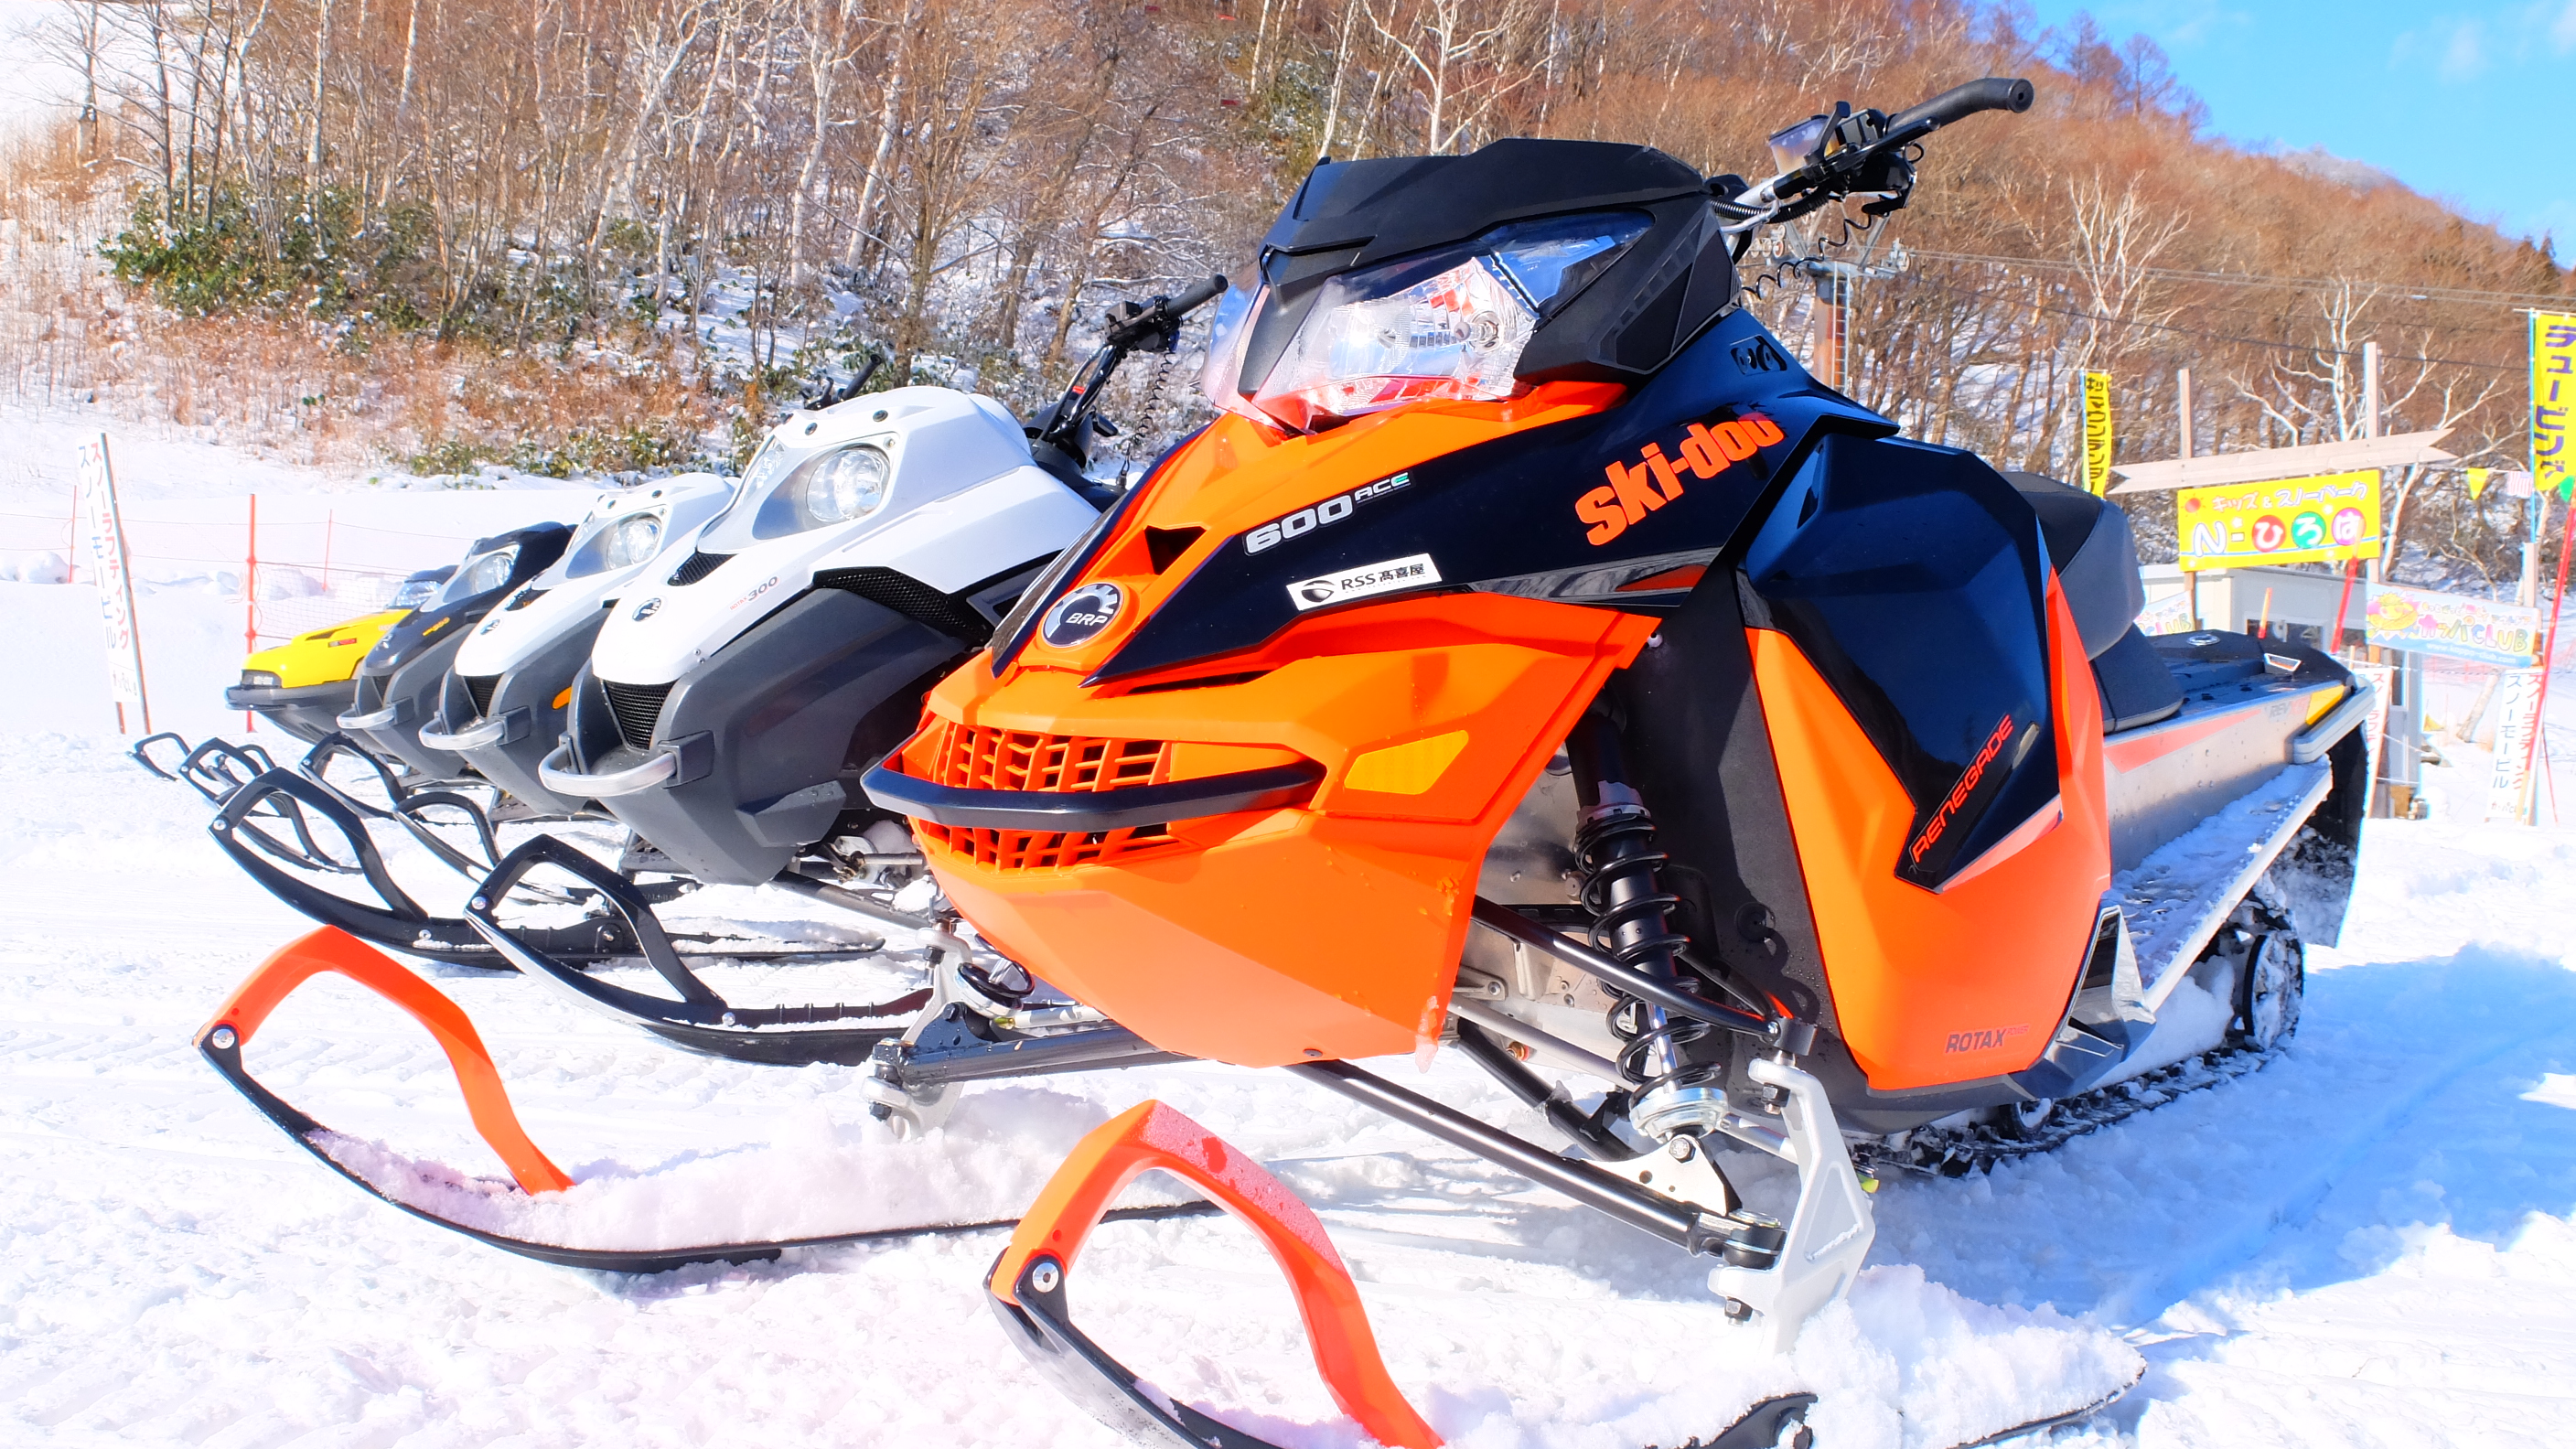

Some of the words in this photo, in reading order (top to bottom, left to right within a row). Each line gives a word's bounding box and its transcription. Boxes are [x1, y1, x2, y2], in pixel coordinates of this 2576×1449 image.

[1245, 494, 1354, 553] 600
[1354, 471, 1411, 501] ACE
[1574, 412, 1785, 546] ski-doo
[2212, 491, 2259, 512] キッズ
[2262, 496, 2273, 510] &
[78, 445, 117, 649] スノーモービル
[90, 442, 130, 650] スノーラフティング
[1341, 573, 1376, 590] RSS
[748, 576, 778, 602] 300
[1065, 612, 1109, 627] BRP
[2493, 675, 2522, 789] スノーモービル
[1912, 714, 2014, 863] RENEGADE
[1945, 1028, 2007, 1054] ROTAX
